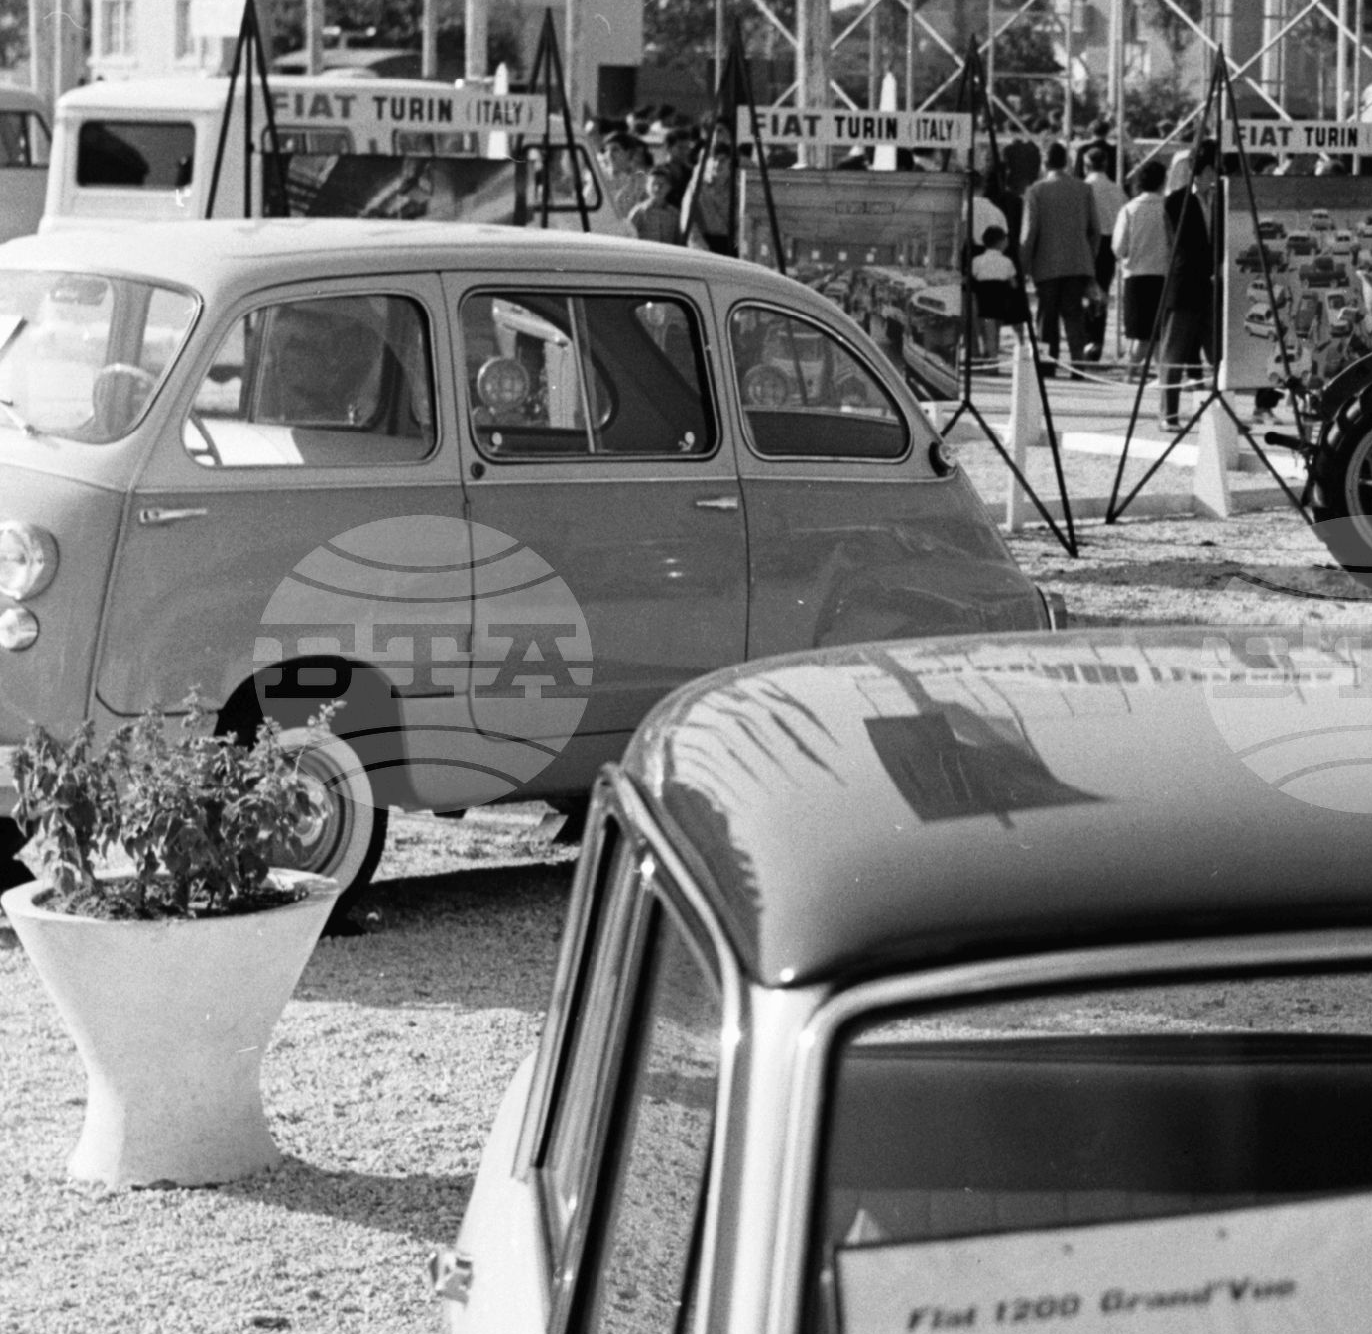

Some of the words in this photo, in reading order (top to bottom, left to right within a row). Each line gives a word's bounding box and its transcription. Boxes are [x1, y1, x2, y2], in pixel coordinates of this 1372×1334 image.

[372, 95, 453, 123] TURIN
[466, 97, 534, 126] (ITALY)
[834, 115, 899, 140] TURIN
[908, 117, 962, 142] (ITALY)
[1232, 125, 1293, 147] FIAT
[1303, 127, 1358, 148] TURIN
[994, 1293, 1082, 1323] 1200
